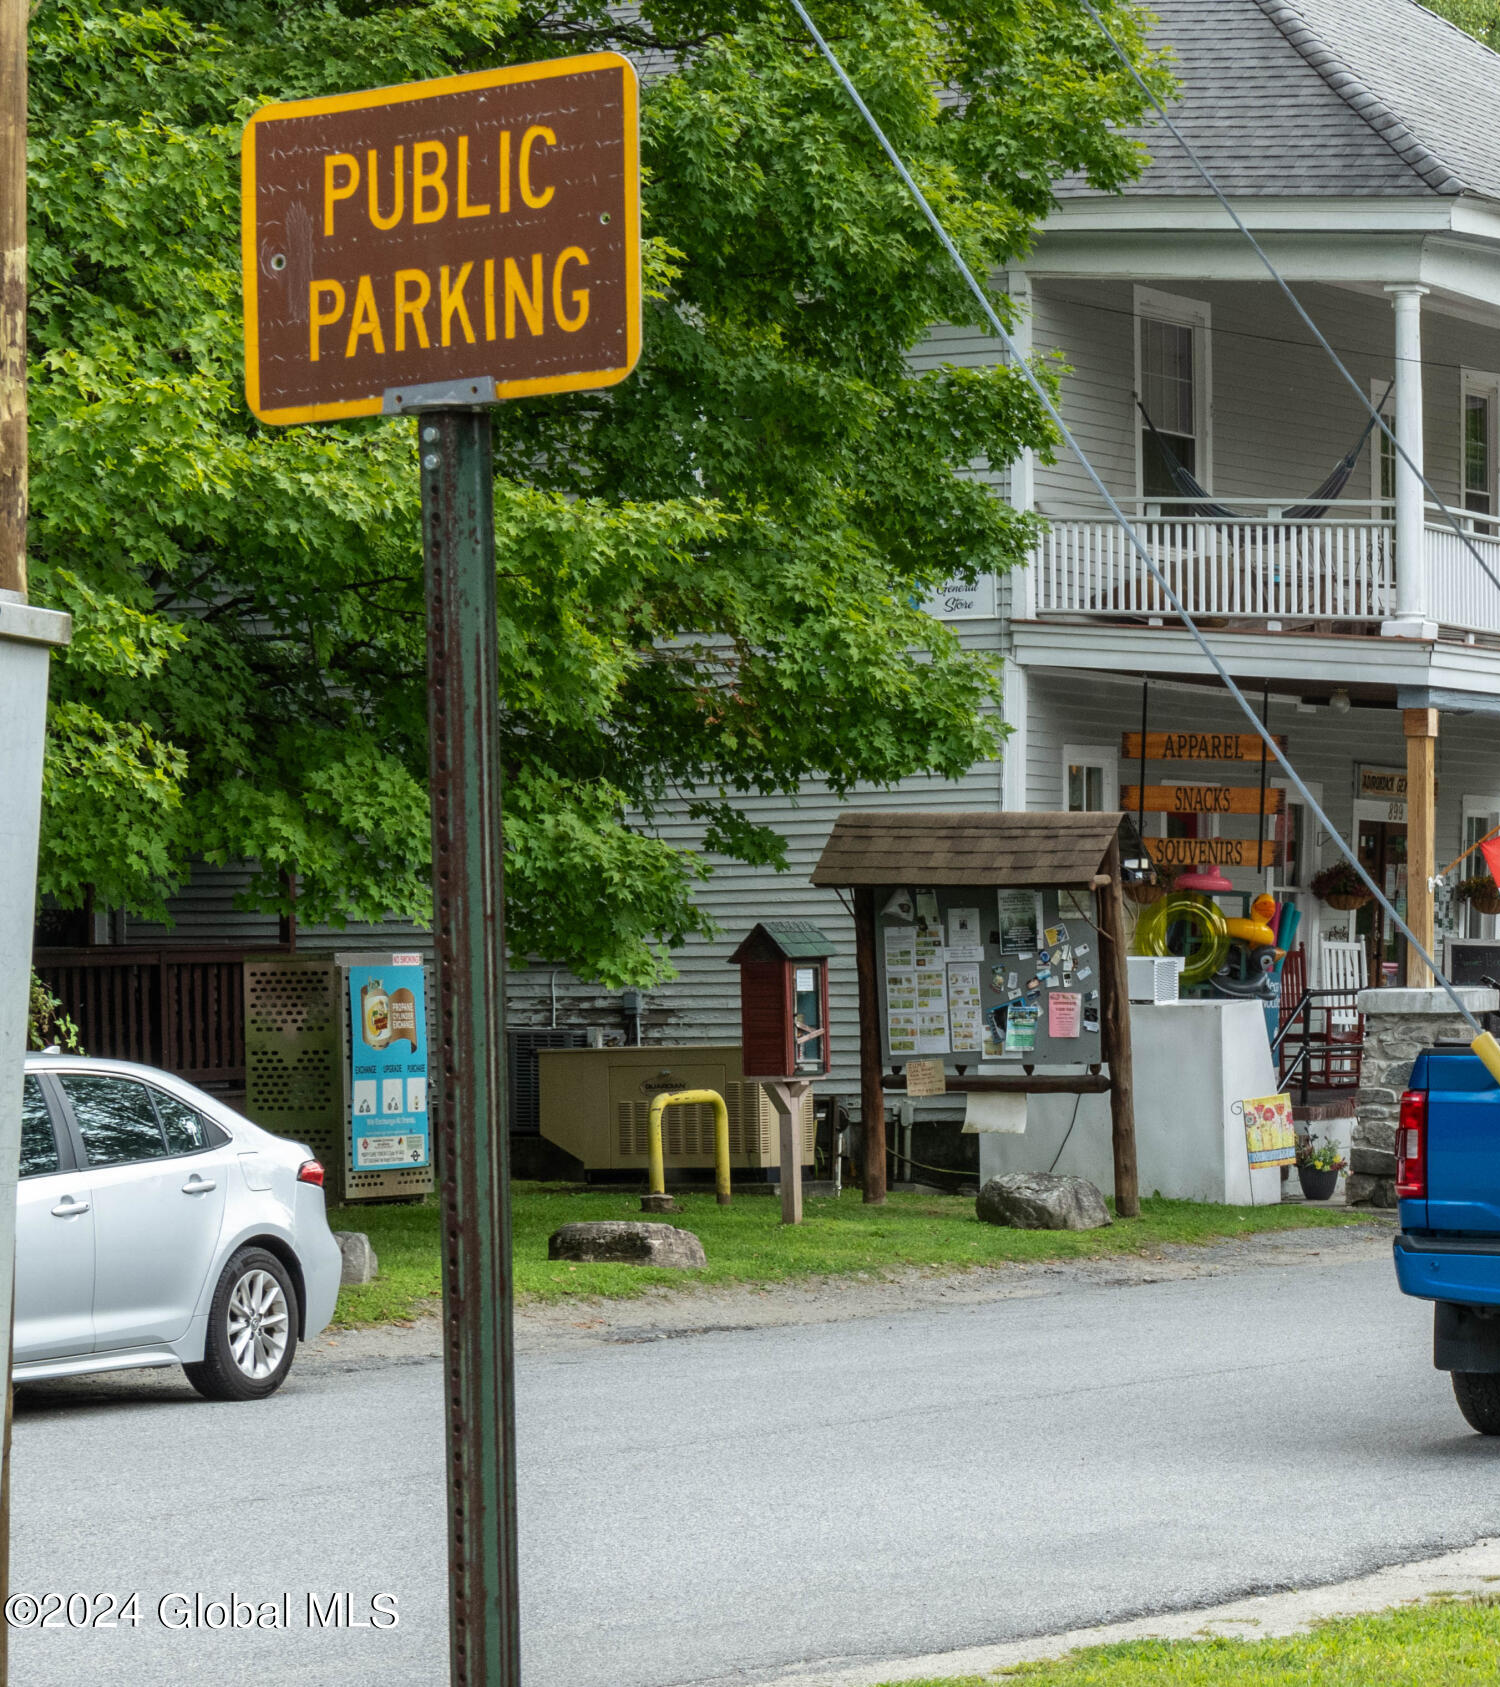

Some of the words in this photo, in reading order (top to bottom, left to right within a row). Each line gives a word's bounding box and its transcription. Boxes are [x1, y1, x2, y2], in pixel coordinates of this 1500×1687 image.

[323, 125, 557, 237] PUBLIC
[309, 245, 591, 363] PARKING
[944, 597, 974, 613] Store
[1162, 735, 1244, 760] APPAREL
[1174, 787, 1231, 812] SNACKS
[1387, 802, 1404, 821] 899
[1156, 839, 1243, 865] SOUVENIRS
[393, 956, 400, 964] NO
[401, 956, 420, 964] SMOKING
